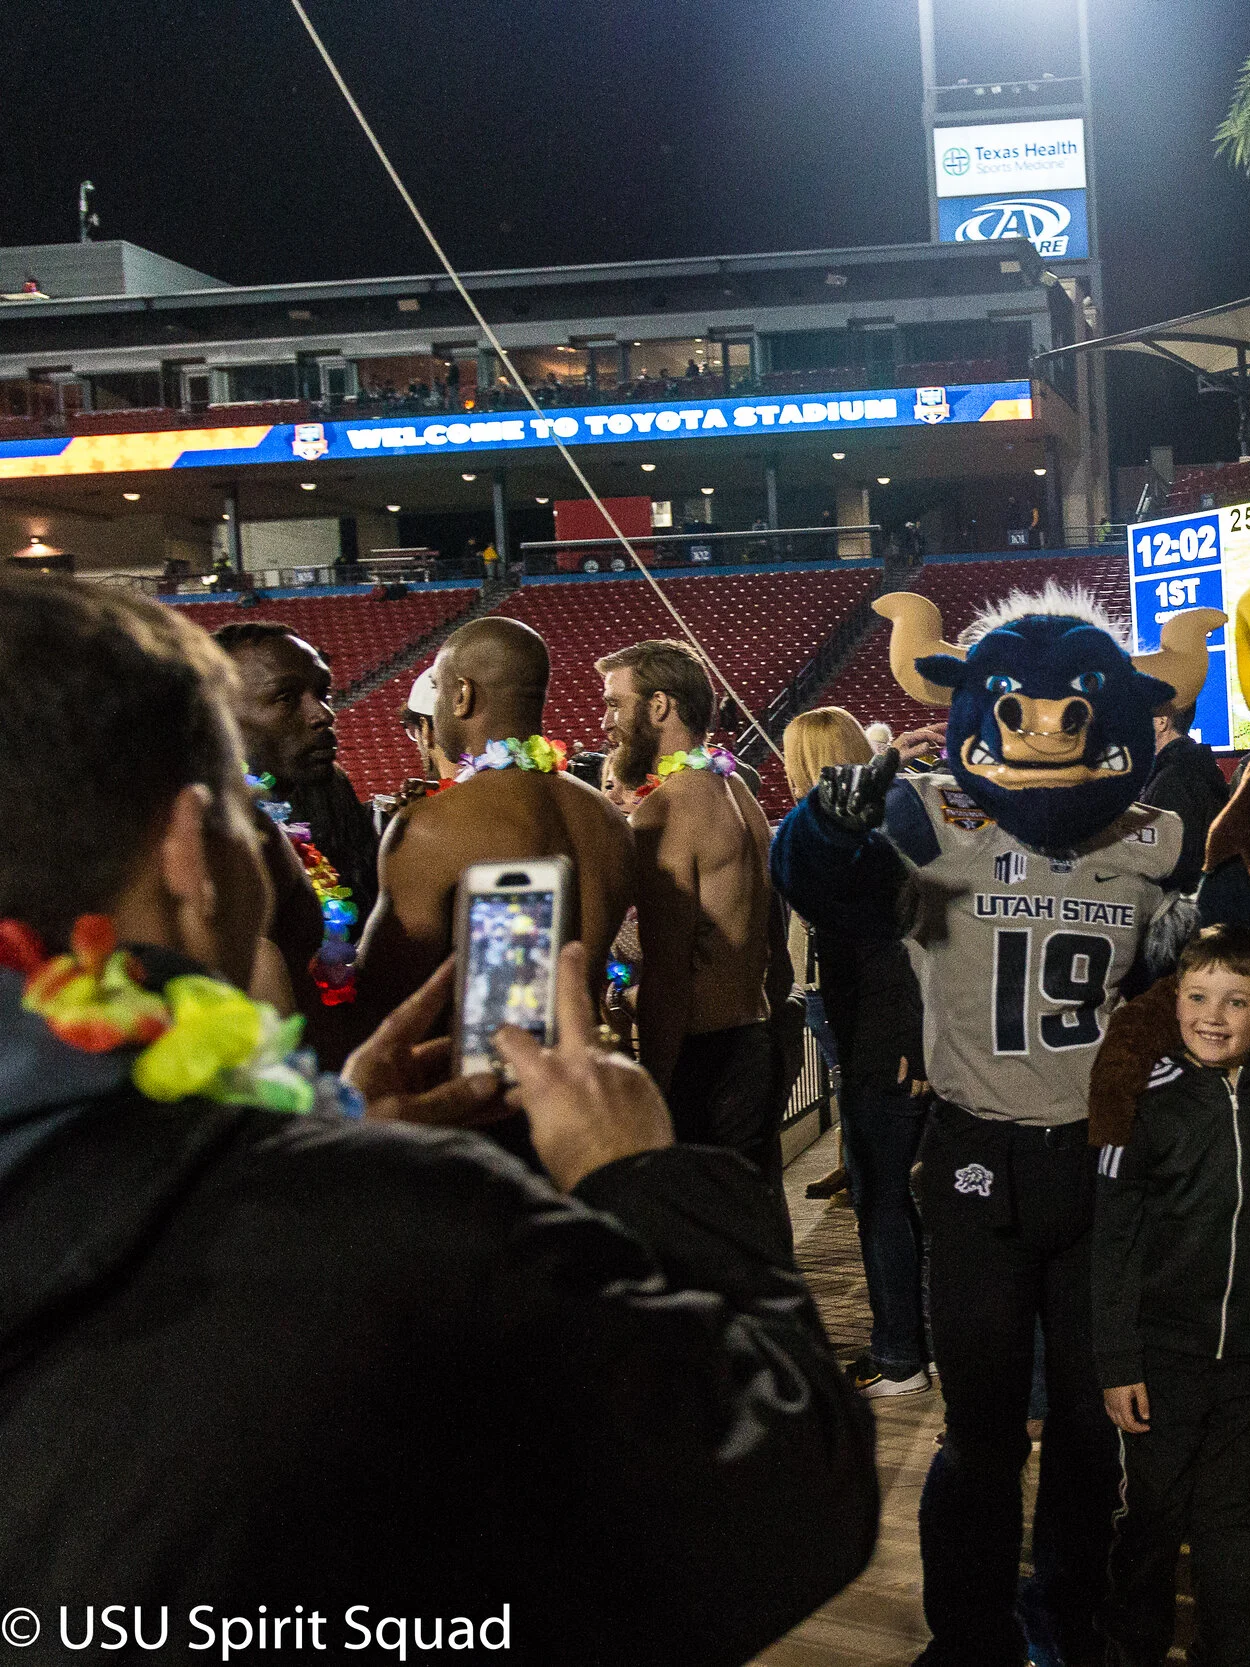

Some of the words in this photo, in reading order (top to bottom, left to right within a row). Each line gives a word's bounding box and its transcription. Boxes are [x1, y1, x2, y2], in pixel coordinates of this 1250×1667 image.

[975, 146, 1019, 161] Texas
[1025, 141, 1078, 157] Health
[976, 160, 1012, 174] Sports
[1015, 158, 1066, 171] Medicine
[347, 420, 525, 449] WELCOME
[530, 417, 579, 439] TO
[585, 409, 729, 435] TOYOTA
[733, 398, 898, 428] STADIUM
[1136, 524, 1218, 568] 12:02
[1155, 577, 1201, 608] 1ST
[974, 893, 1055, 919] UTAH
[1060, 898, 1136, 929] STATE
[991, 926, 1115, 1056] 19
